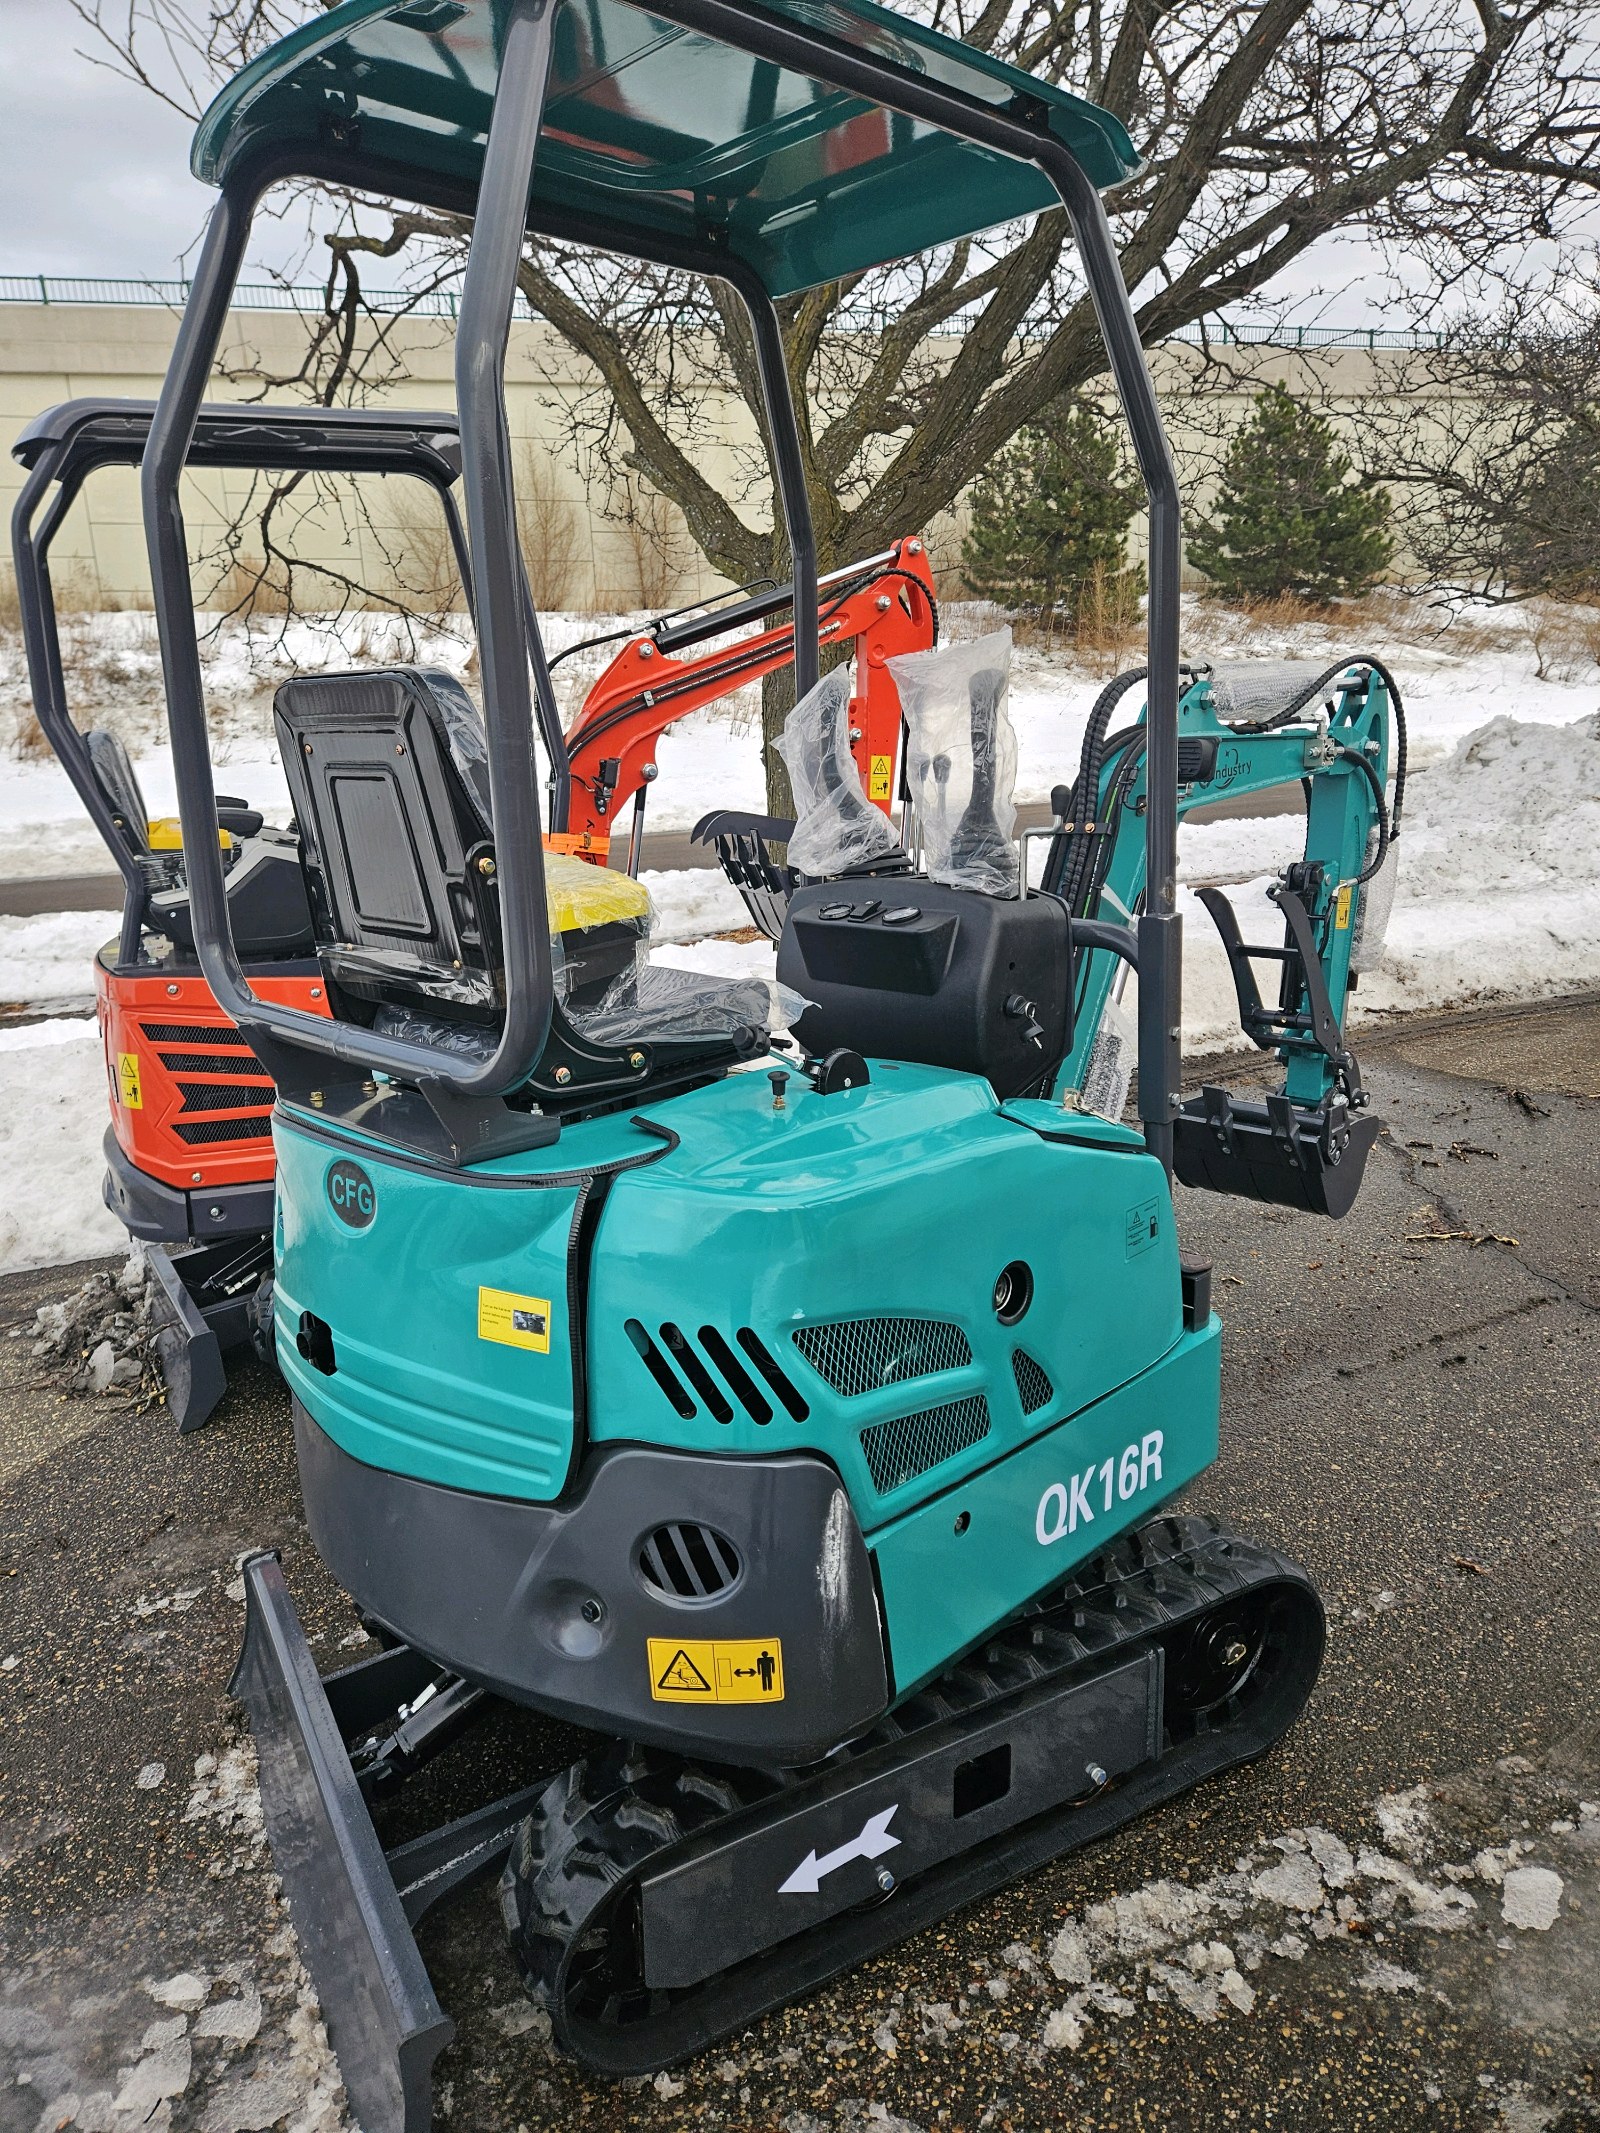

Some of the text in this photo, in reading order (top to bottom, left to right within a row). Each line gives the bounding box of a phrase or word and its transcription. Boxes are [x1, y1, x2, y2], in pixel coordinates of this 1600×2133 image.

[1215, 760, 1252, 780] ndustry
[332, 1174, 373, 1215] CFG
[1036, 1429, 1163, 1546] QK16R
